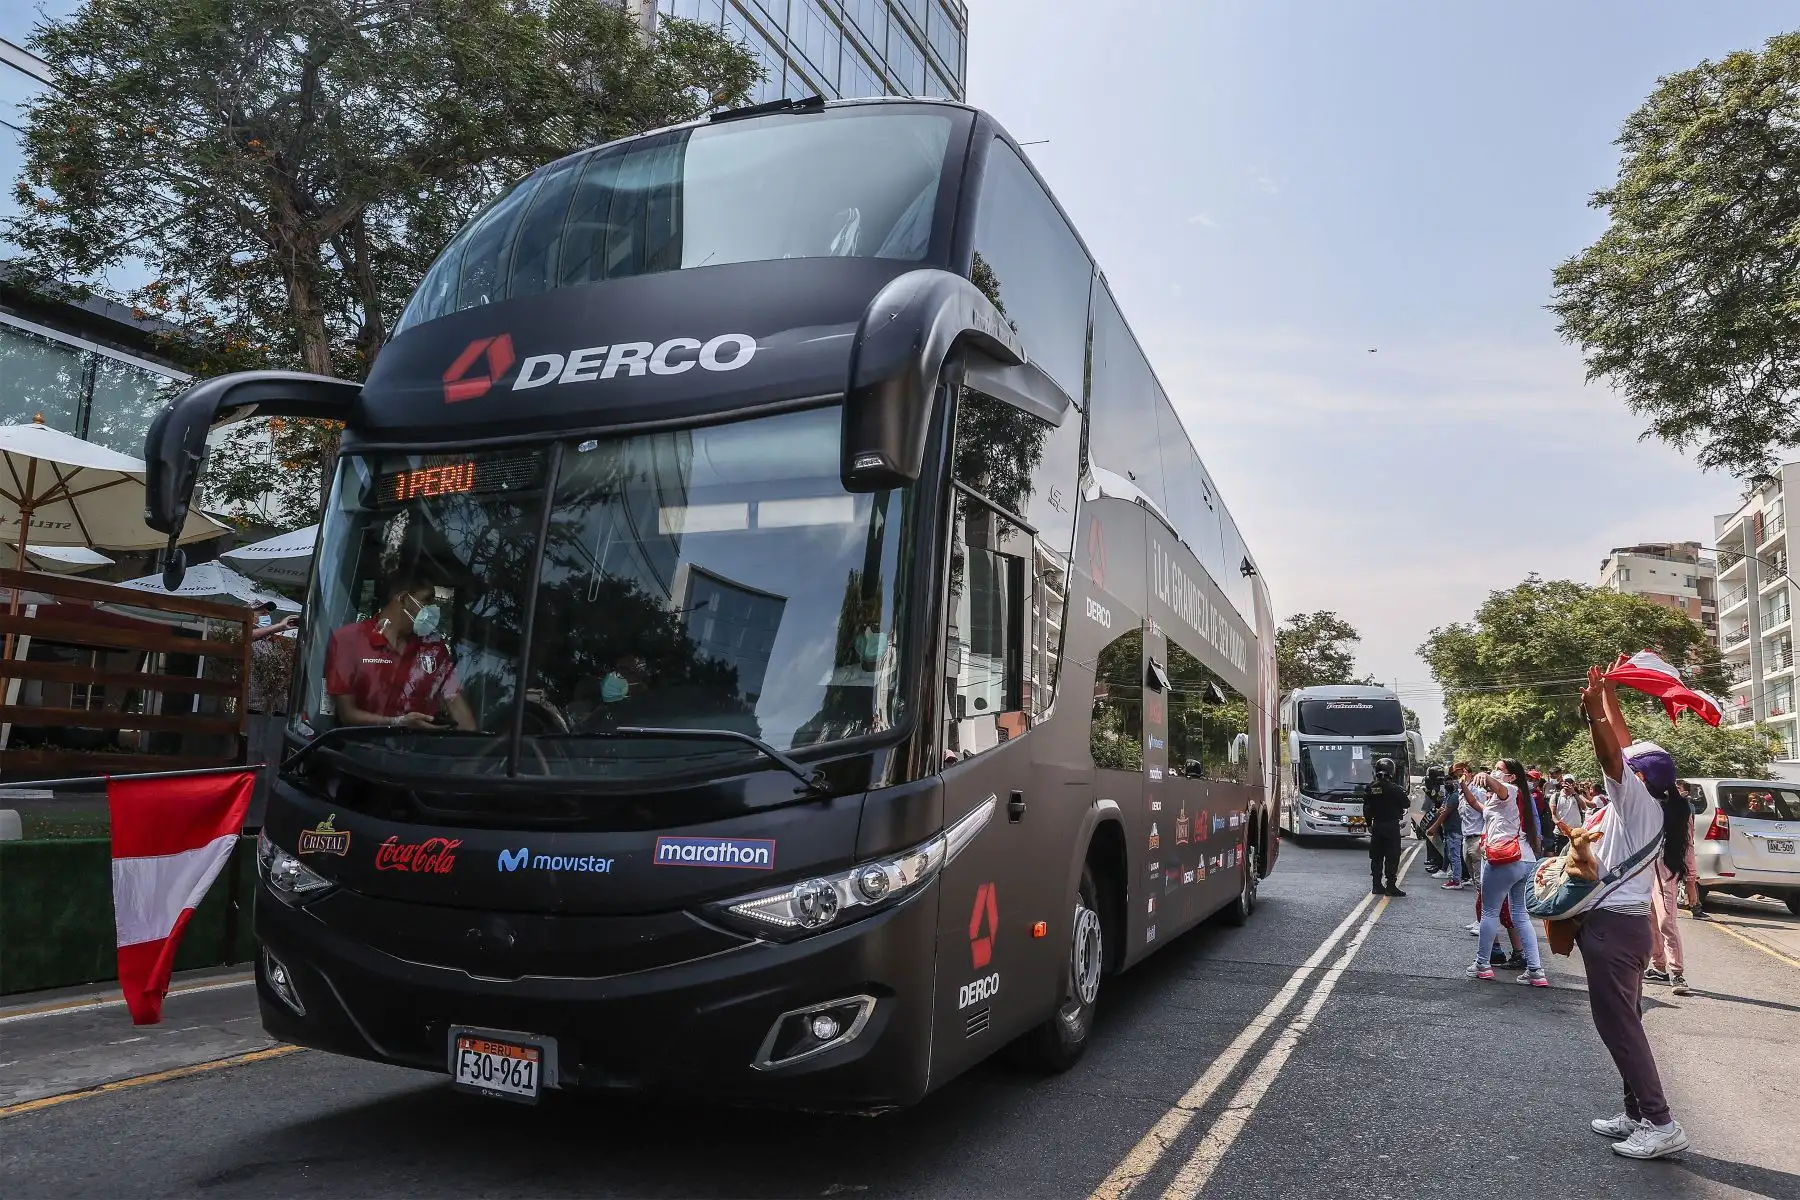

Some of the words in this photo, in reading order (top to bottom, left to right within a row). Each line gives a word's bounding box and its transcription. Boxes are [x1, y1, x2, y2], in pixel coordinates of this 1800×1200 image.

[512, 333, 757, 391] DERCO
[133, 581, 164, 590] STELL
[1086, 597, 1111, 629] DERCO
[362, 657, 393, 665] marathon
[303, 834, 345, 851] CRISTAL
[659, 842, 769, 864] marathon
[533, 854, 615, 874] movistar
[958, 972, 1000, 1010] DERCO
[483, 1043, 512, 1057] PERU
[459, 1049, 534, 1090] F30-961
